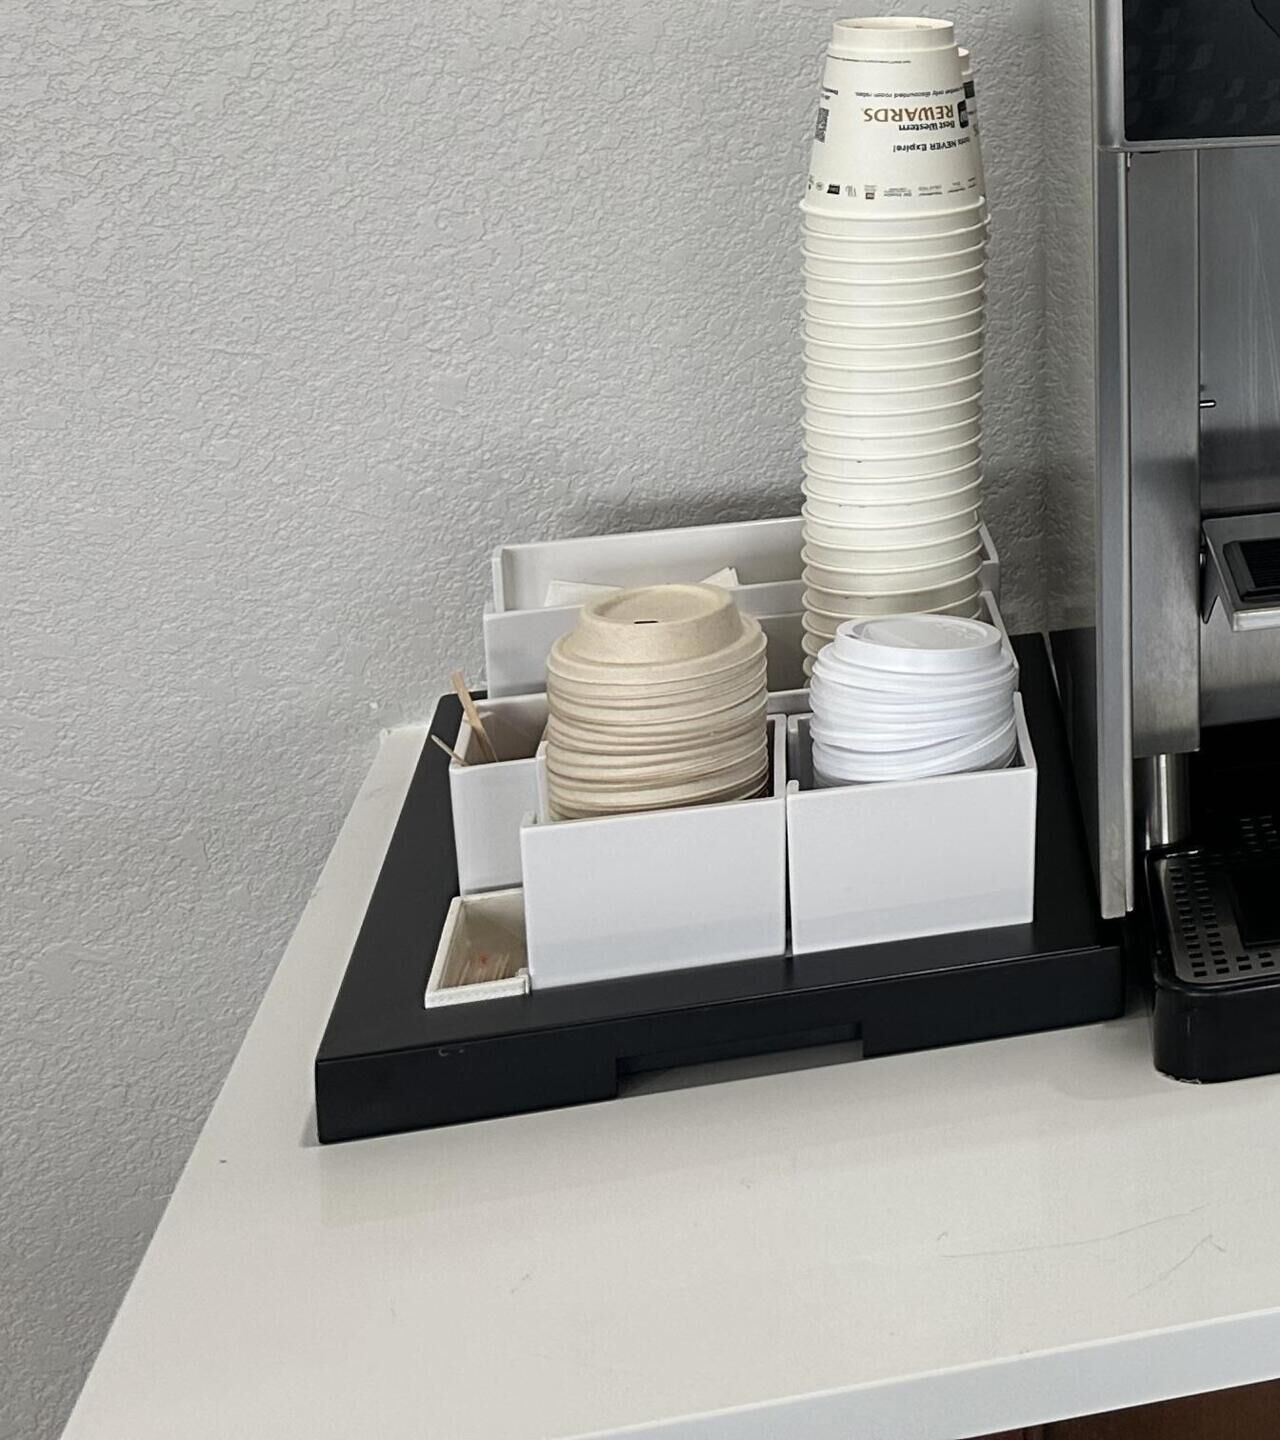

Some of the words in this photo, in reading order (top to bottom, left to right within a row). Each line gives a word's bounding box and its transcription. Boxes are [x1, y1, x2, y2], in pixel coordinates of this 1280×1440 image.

[863, 104, 955, 123] REWARDS
[898, 122, 938, 132] Western
[938, 120, 956, 131] Best
[892, 143, 927, 153] Expire!
[929, 139, 957, 151] NEVER
